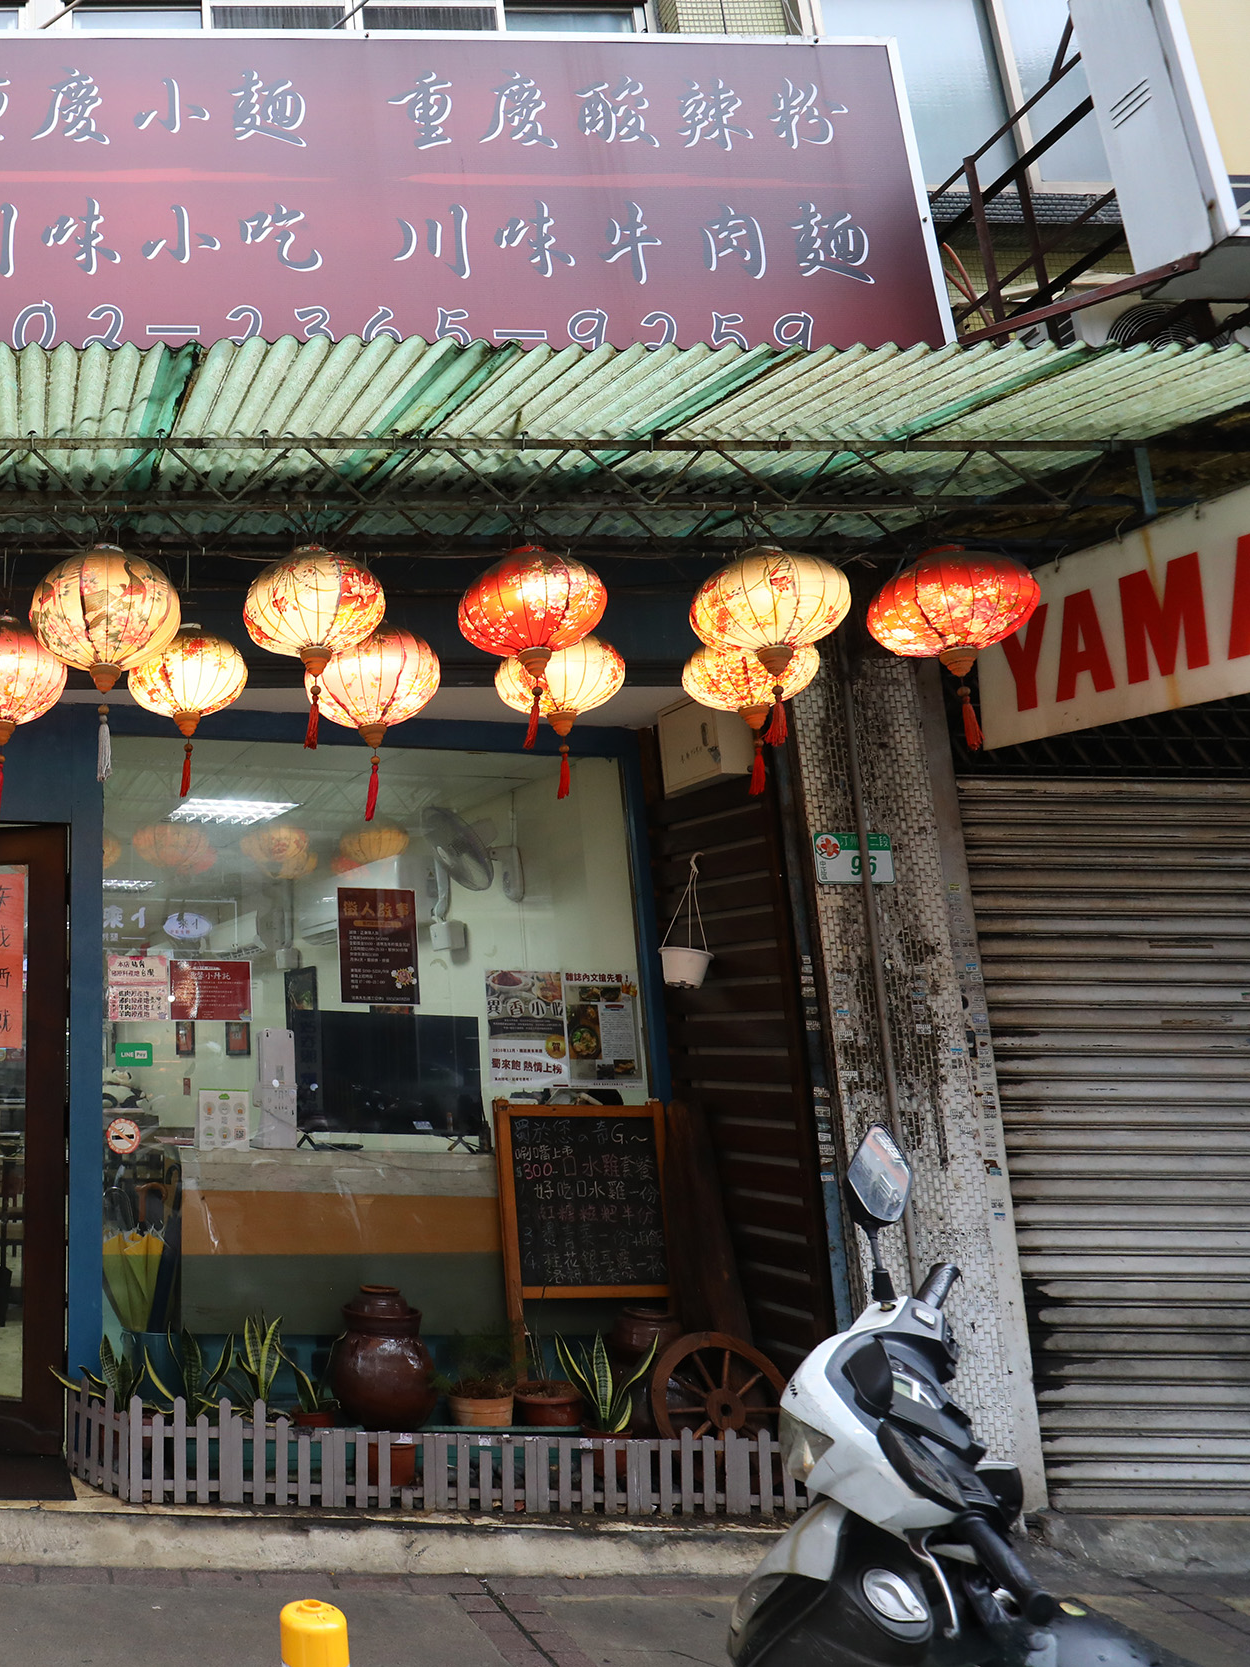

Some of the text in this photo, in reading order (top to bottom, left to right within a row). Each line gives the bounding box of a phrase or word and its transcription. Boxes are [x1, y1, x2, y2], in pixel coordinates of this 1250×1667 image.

[387, 70, 848, 151] 重慶酸辣粉
[393, 200, 875, 285] 川味牛肉麵
[841, 835, 889, 848] 汀州二段
[851, 855, 877, 876] 96
[491, 1057, 563, 1075] 蜀來飽 熱情上榜
